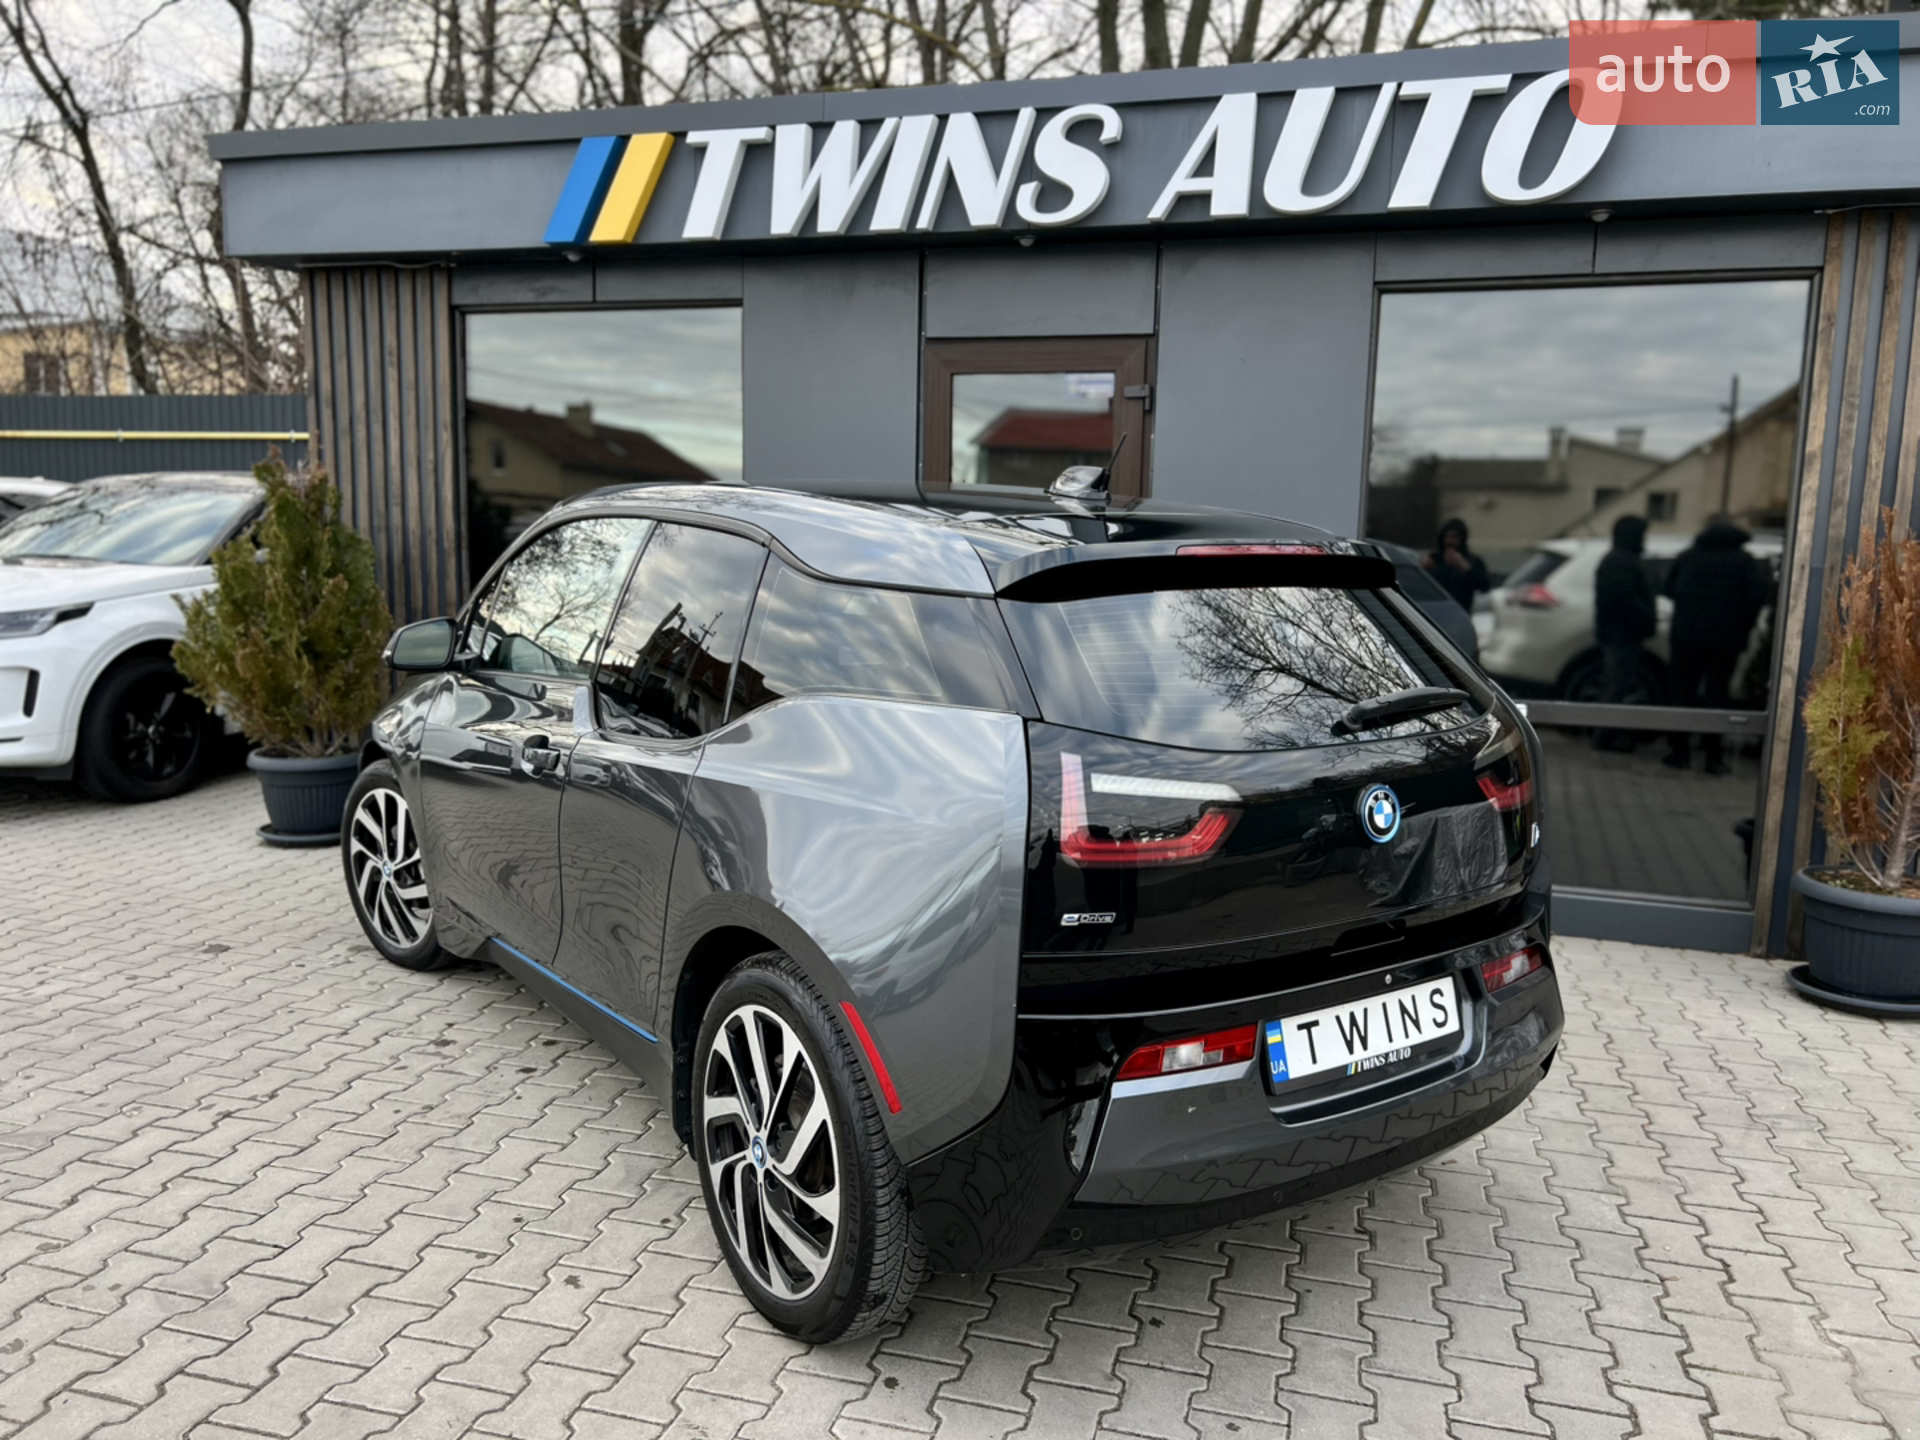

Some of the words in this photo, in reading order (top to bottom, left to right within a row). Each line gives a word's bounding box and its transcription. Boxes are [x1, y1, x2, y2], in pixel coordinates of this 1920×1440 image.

[682, 103, 1122, 240] TWINS
[1148, 68, 1623, 222] AUTO
[1296, 987, 1448, 1065] TWINS
[1271, 1061, 1287, 1075] UA
[1357, 1054, 1386, 1073] TWINS
[1387, 1047, 1411, 1064] AUTO
